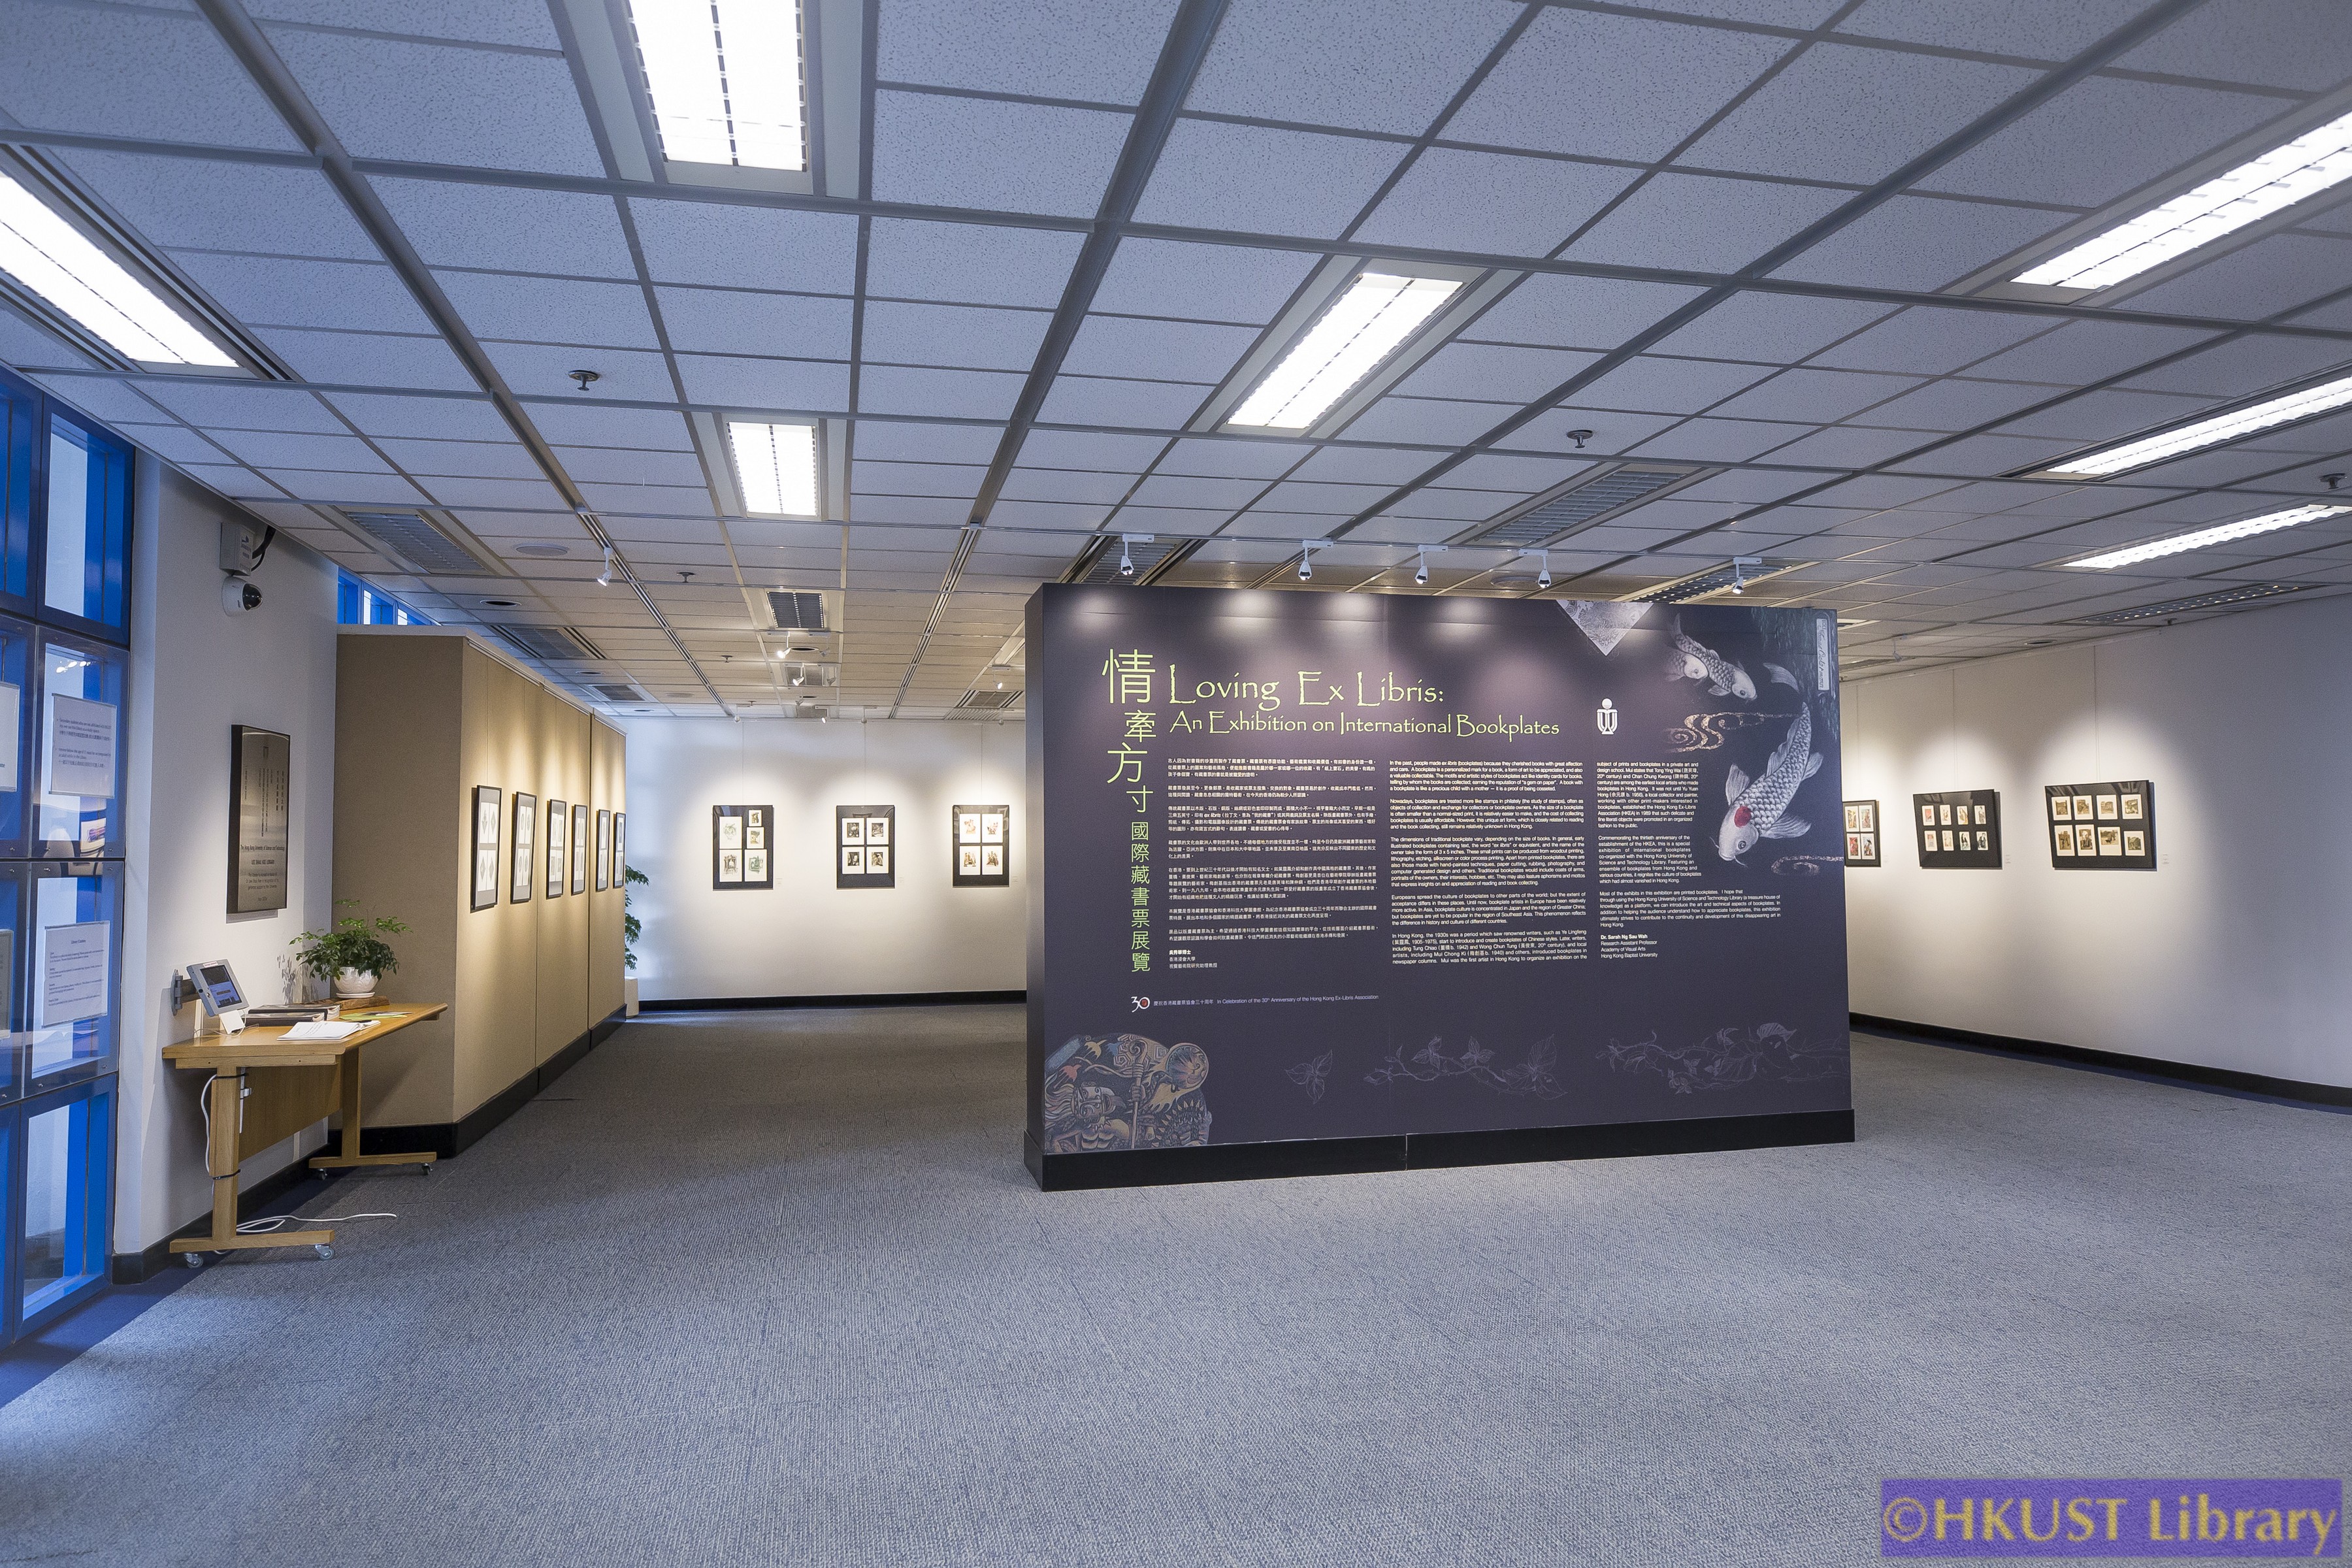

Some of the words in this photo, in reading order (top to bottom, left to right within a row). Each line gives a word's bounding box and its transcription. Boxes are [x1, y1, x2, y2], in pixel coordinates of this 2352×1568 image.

[1169, 664, 1281, 711] Loving
[1298, 670, 1345, 706] Ex
[1357, 672, 1444, 706] Libris:
[1169, 710, 1203, 734] An
[1209, 710, 1307, 734] Exhibition
[1312, 720, 1334, 732] on
[1340, 711, 1451, 735] International
[1456, 713, 1560, 743] Bookplates
[1131, 821, 1151, 972] 國際藏書票展覽
